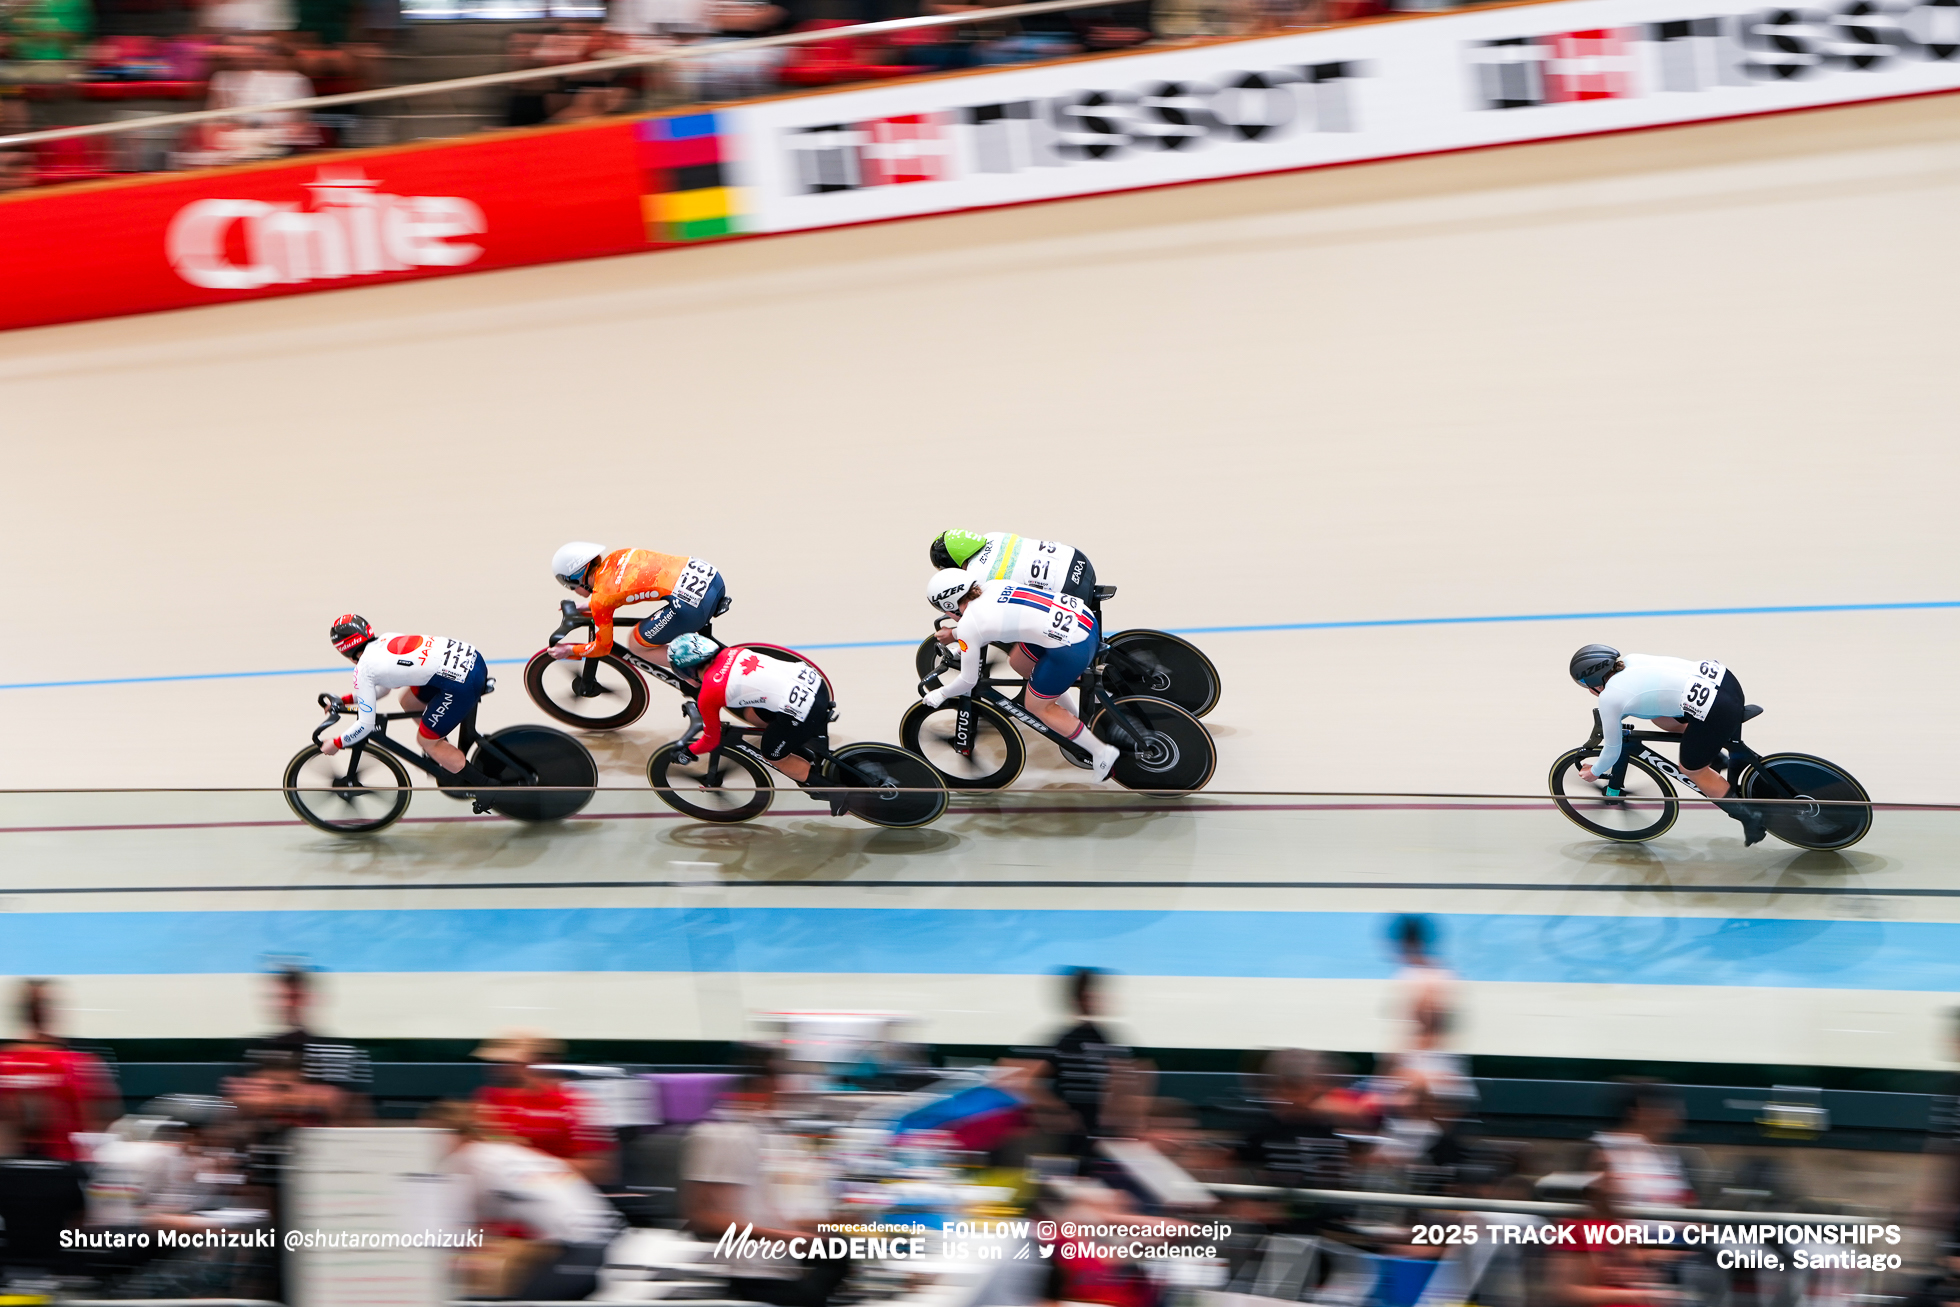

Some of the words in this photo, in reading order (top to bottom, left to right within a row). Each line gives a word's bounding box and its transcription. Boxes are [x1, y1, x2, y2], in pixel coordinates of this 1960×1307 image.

[1630, 0, 1960, 92] TISSO
[954, 59, 1374, 173] TISSOT
[1030, 559, 1050, 580] 61
[681, 573, 708, 598] 122
[932, 583, 965, 603] LAZER
[997, 585, 1015, 603] GBR
[1052, 611, 1073, 633] 92
[418, 636, 435, 666] JAPA
[443, 649, 469, 673] 114
[622, 653, 681, 690] KOGA
[713, 648, 738, 683] Canada
[1576, 659, 1610, 680] LAZER
[788, 685, 809, 708] 67
[1687, 682, 1710, 707] 59
[428, 692, 453, 728] JAPAN
[996, 698, 1050, 732] hope
[957, 710, 970, 746] LOTUS
